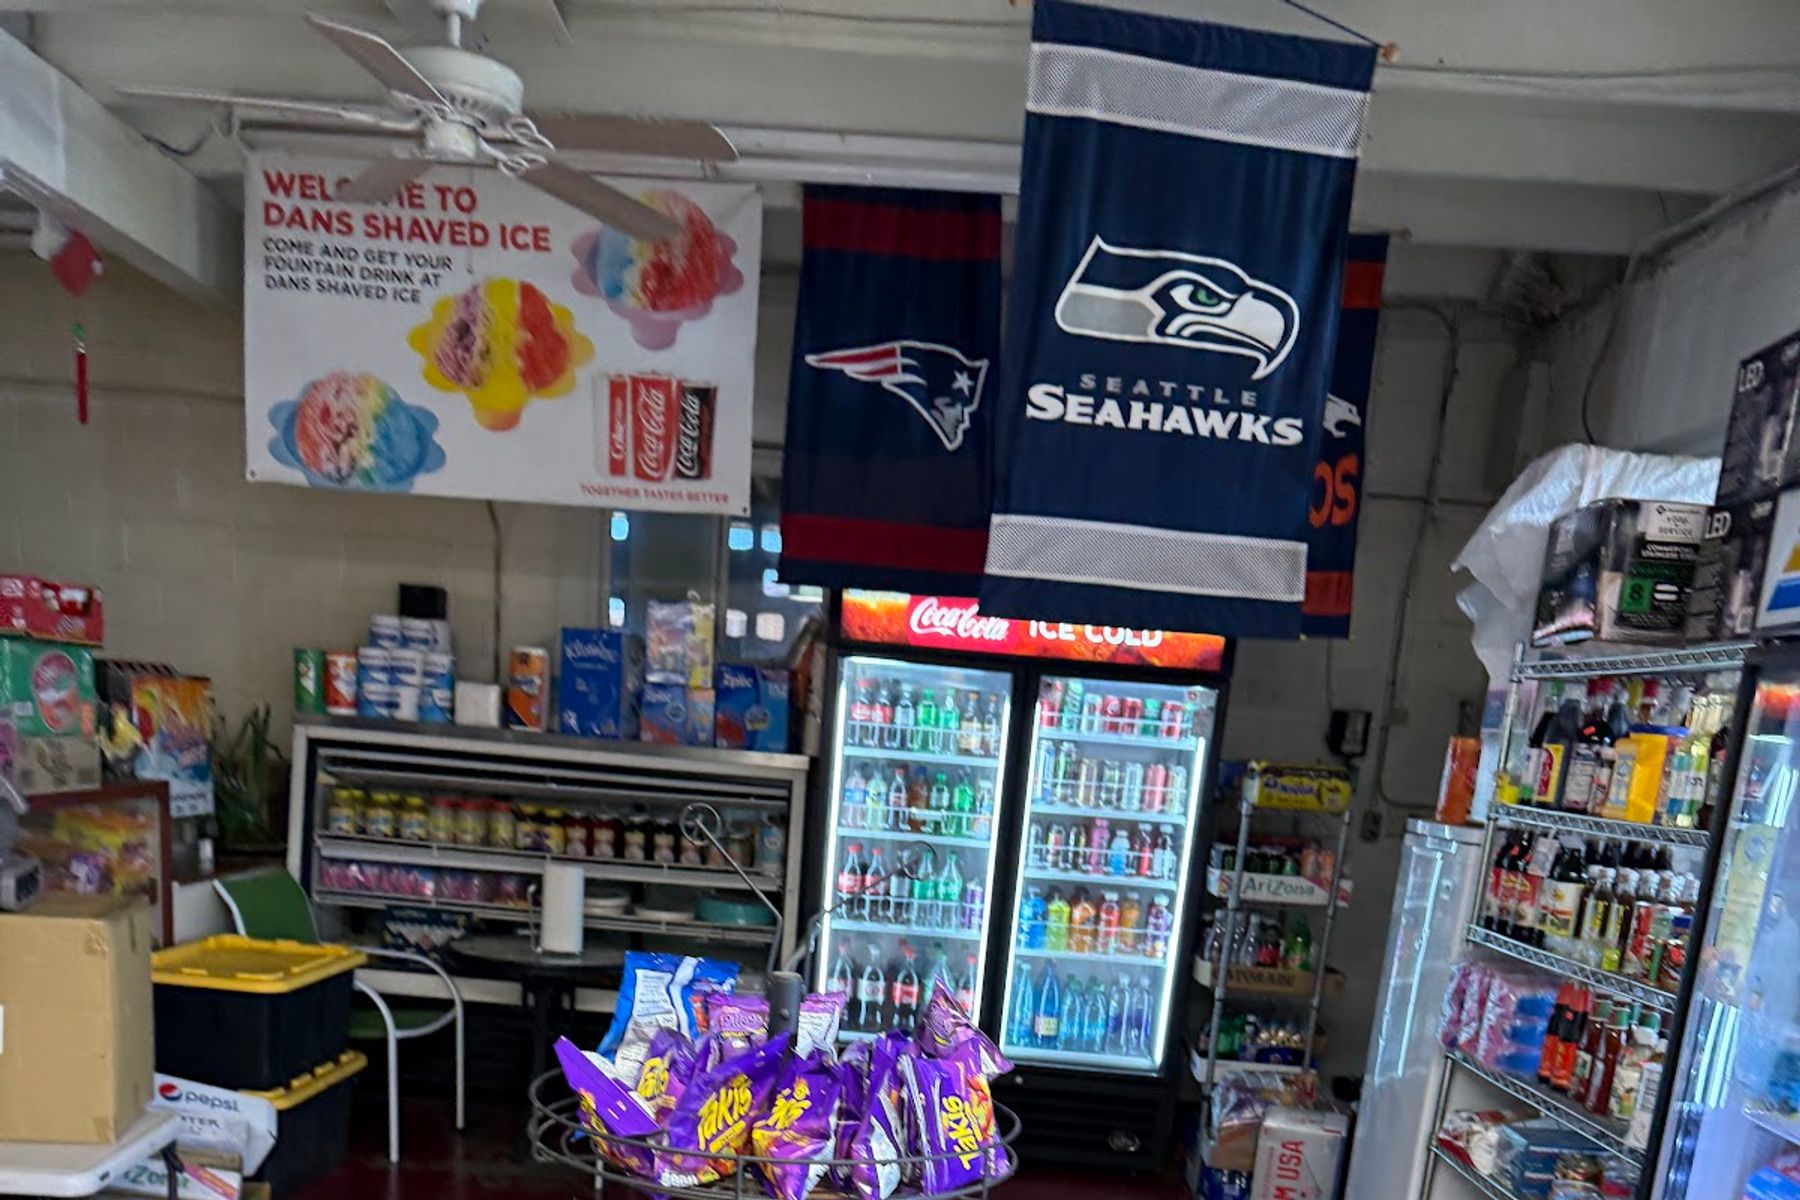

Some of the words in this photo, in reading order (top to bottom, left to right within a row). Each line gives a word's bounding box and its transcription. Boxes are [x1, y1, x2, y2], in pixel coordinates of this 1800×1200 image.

[433, 184, 477, 214] TO
[263, 201, 354, 236] DANS
[363, 212, 490, 247] SHAVED
[499, 223, 552, 252] ICE
[263, 237, 313, 255] COME
[320, 244, 359, 261] AND
[363, 249, 398, 265] GET
[404, 253, 453, 271] YOUR
[264, 255, 355, 279] FOUNTAIN
[359, 266, 414, 285] DRINK
[420, 272, 441, 287] AT
[265, 275, 311, 292] DANS
[315, 278, 388, 300] SHAVED
[393, 287, 421, 303] ICE
[1080, 372, 1257, 408] SEATTLE
[1025, 382, 1304, 447] SEAHAWKS
[185, 1091, 240, 1112] pepsi
[1276, 1139, 1305, 1181] USA
